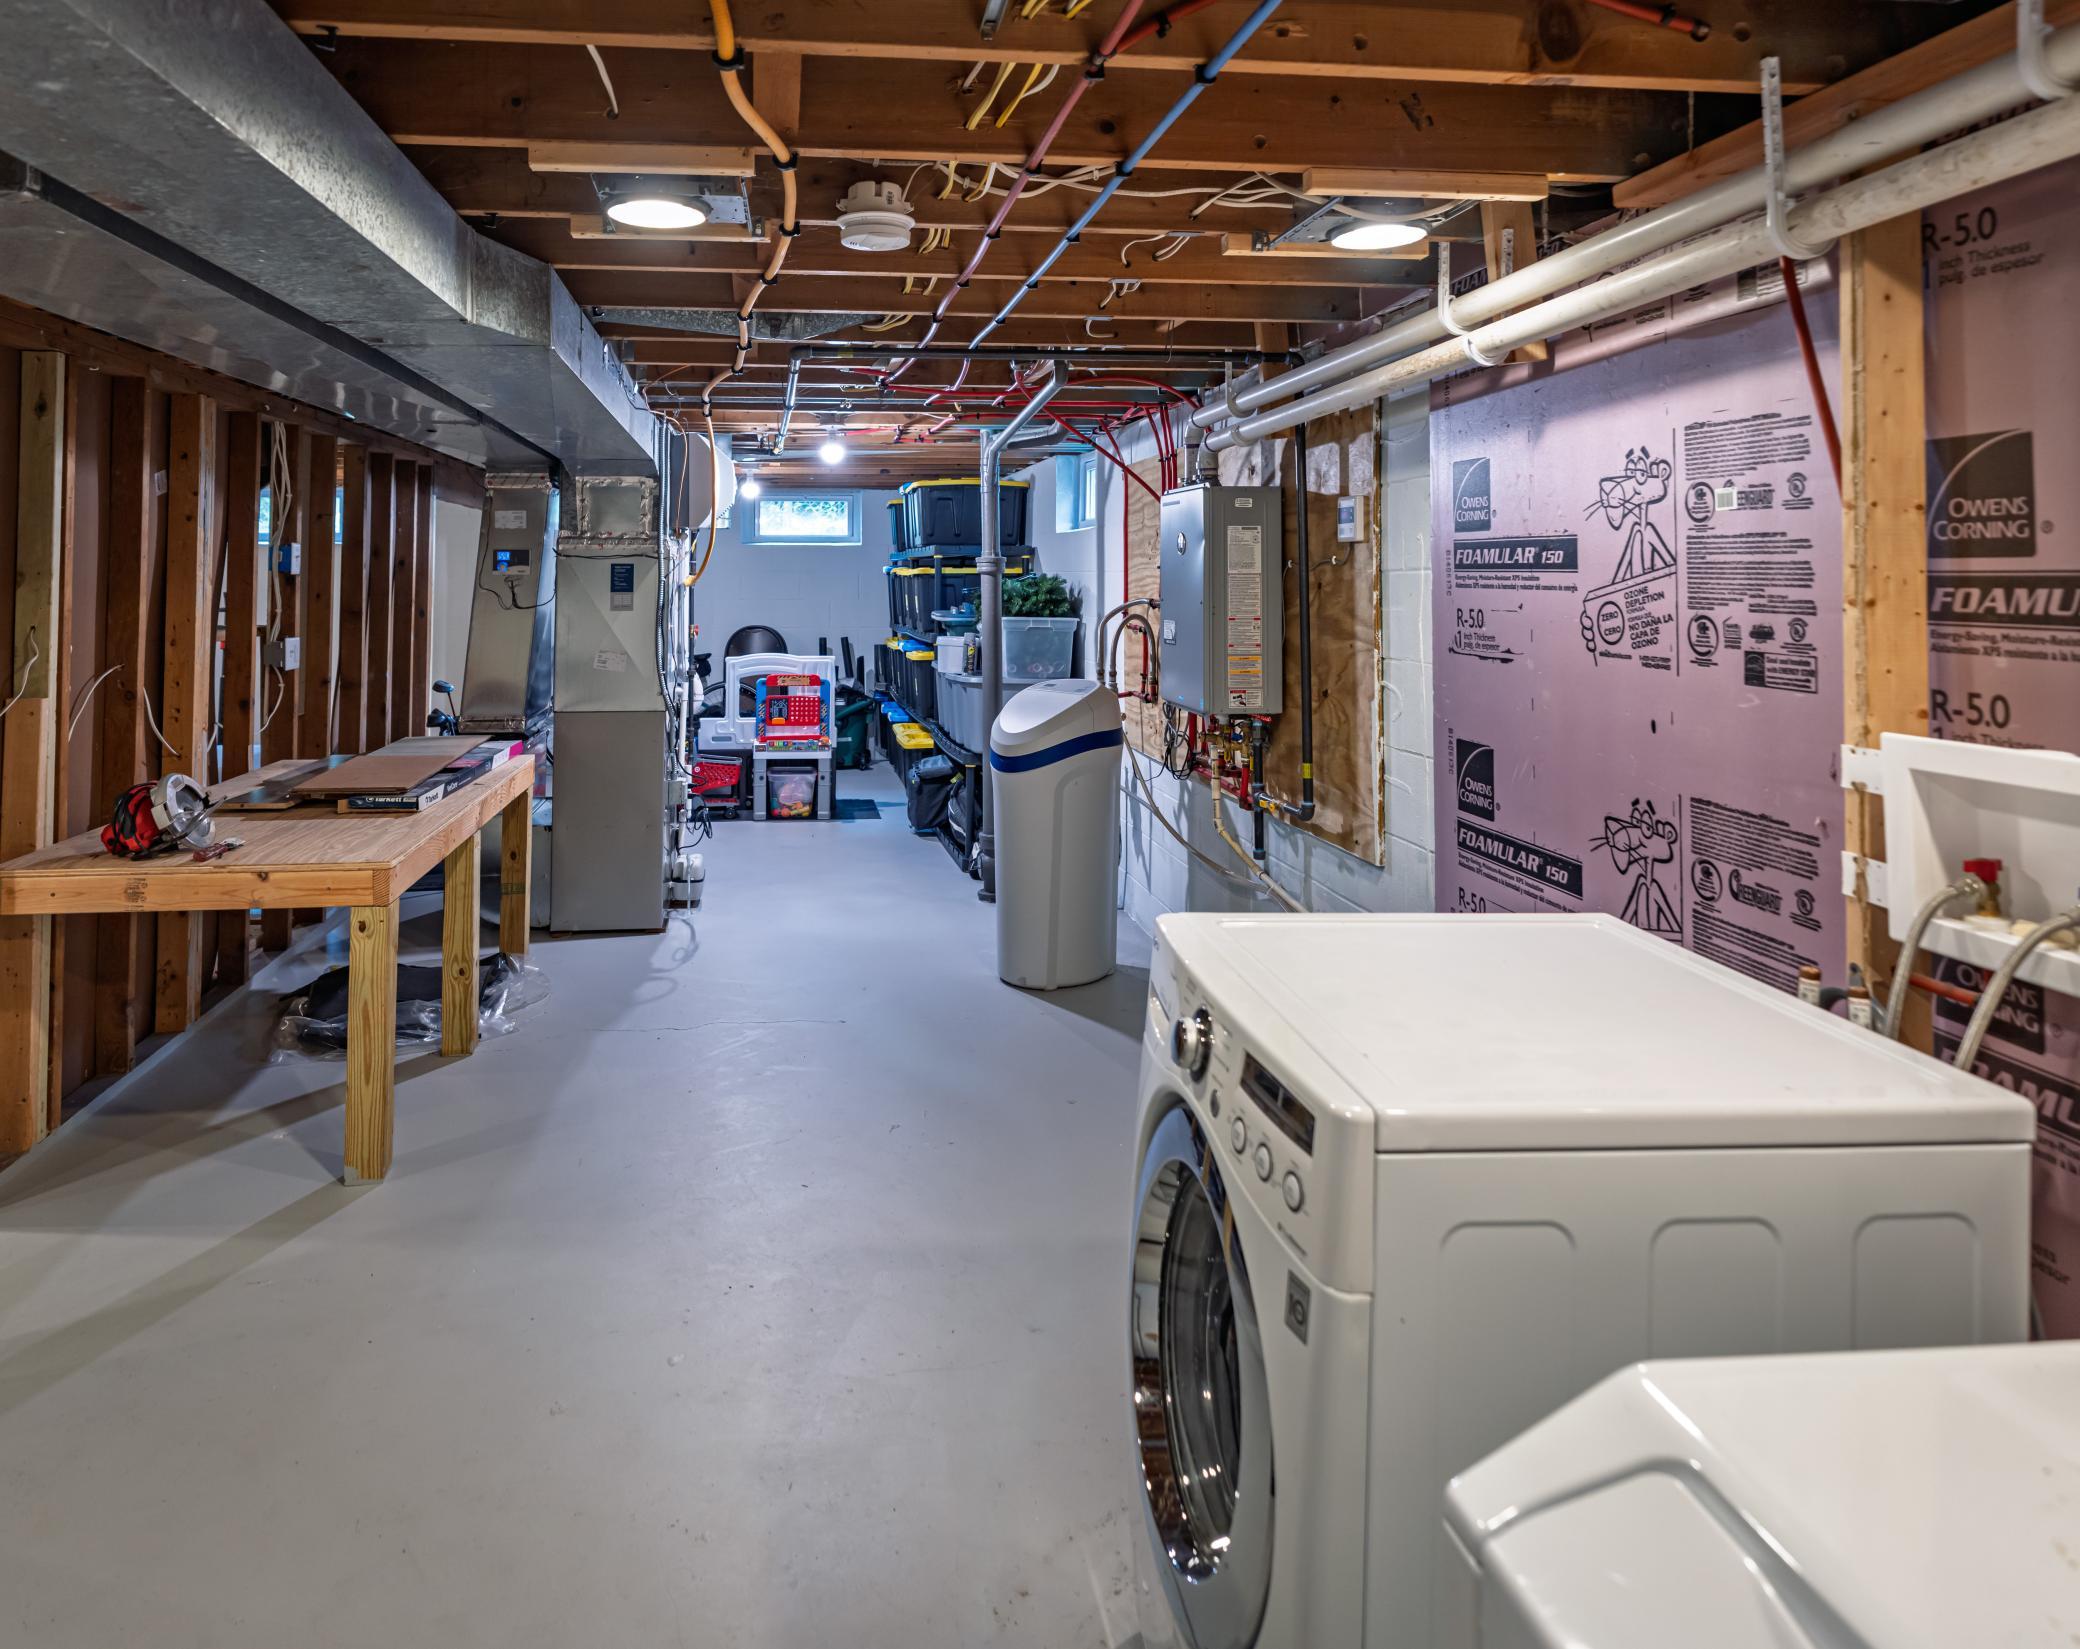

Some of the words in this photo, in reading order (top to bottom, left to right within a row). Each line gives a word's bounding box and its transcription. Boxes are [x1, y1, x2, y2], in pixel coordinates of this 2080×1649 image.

[1922, 206, 1997, 251] R-5.0
[1461, 495, 1489, 509] OWENS
[1948, 496, 2029, 518] OWENS
[1456, 509, 1489, 521] CORNING
[1933, 520, 2031, 540] CORNING
[1455, 547, 1536, 565] FOAMULAR
[1541, 550, 1564, 564] 150
[1624, 586, 1649, 600] OZONE
[1625, 591, 1665, 609] DEPLETION
[1930, 587, 2080, 617] FOAMU
[1457, 608, 1484, 628] R-5.0
[1601, 611, 1619, 622] ZERO
[1629, 623, 1640, 632] NO
[1662, 613, 1674, 623] LA
[1604, 626, 1621, 636] CERO
[1630, 630, 1649, 641] CAPA
[1650, 626, 1660, 636] DE
[1631, 637, 1659, 649] OZONO
[1931, 688, 2011, 729] R-5.0
[1464, 777, 1492, 797] OWENS
[1459, 788, 1493, 810] CORNING
[1459, 828, 1541, 873] FOAMULAR
[1545, 865, 1568, 884] 150
[1458, 886, 1486, 912] R-50
[1956, 964, 2038, 1009] OENS
